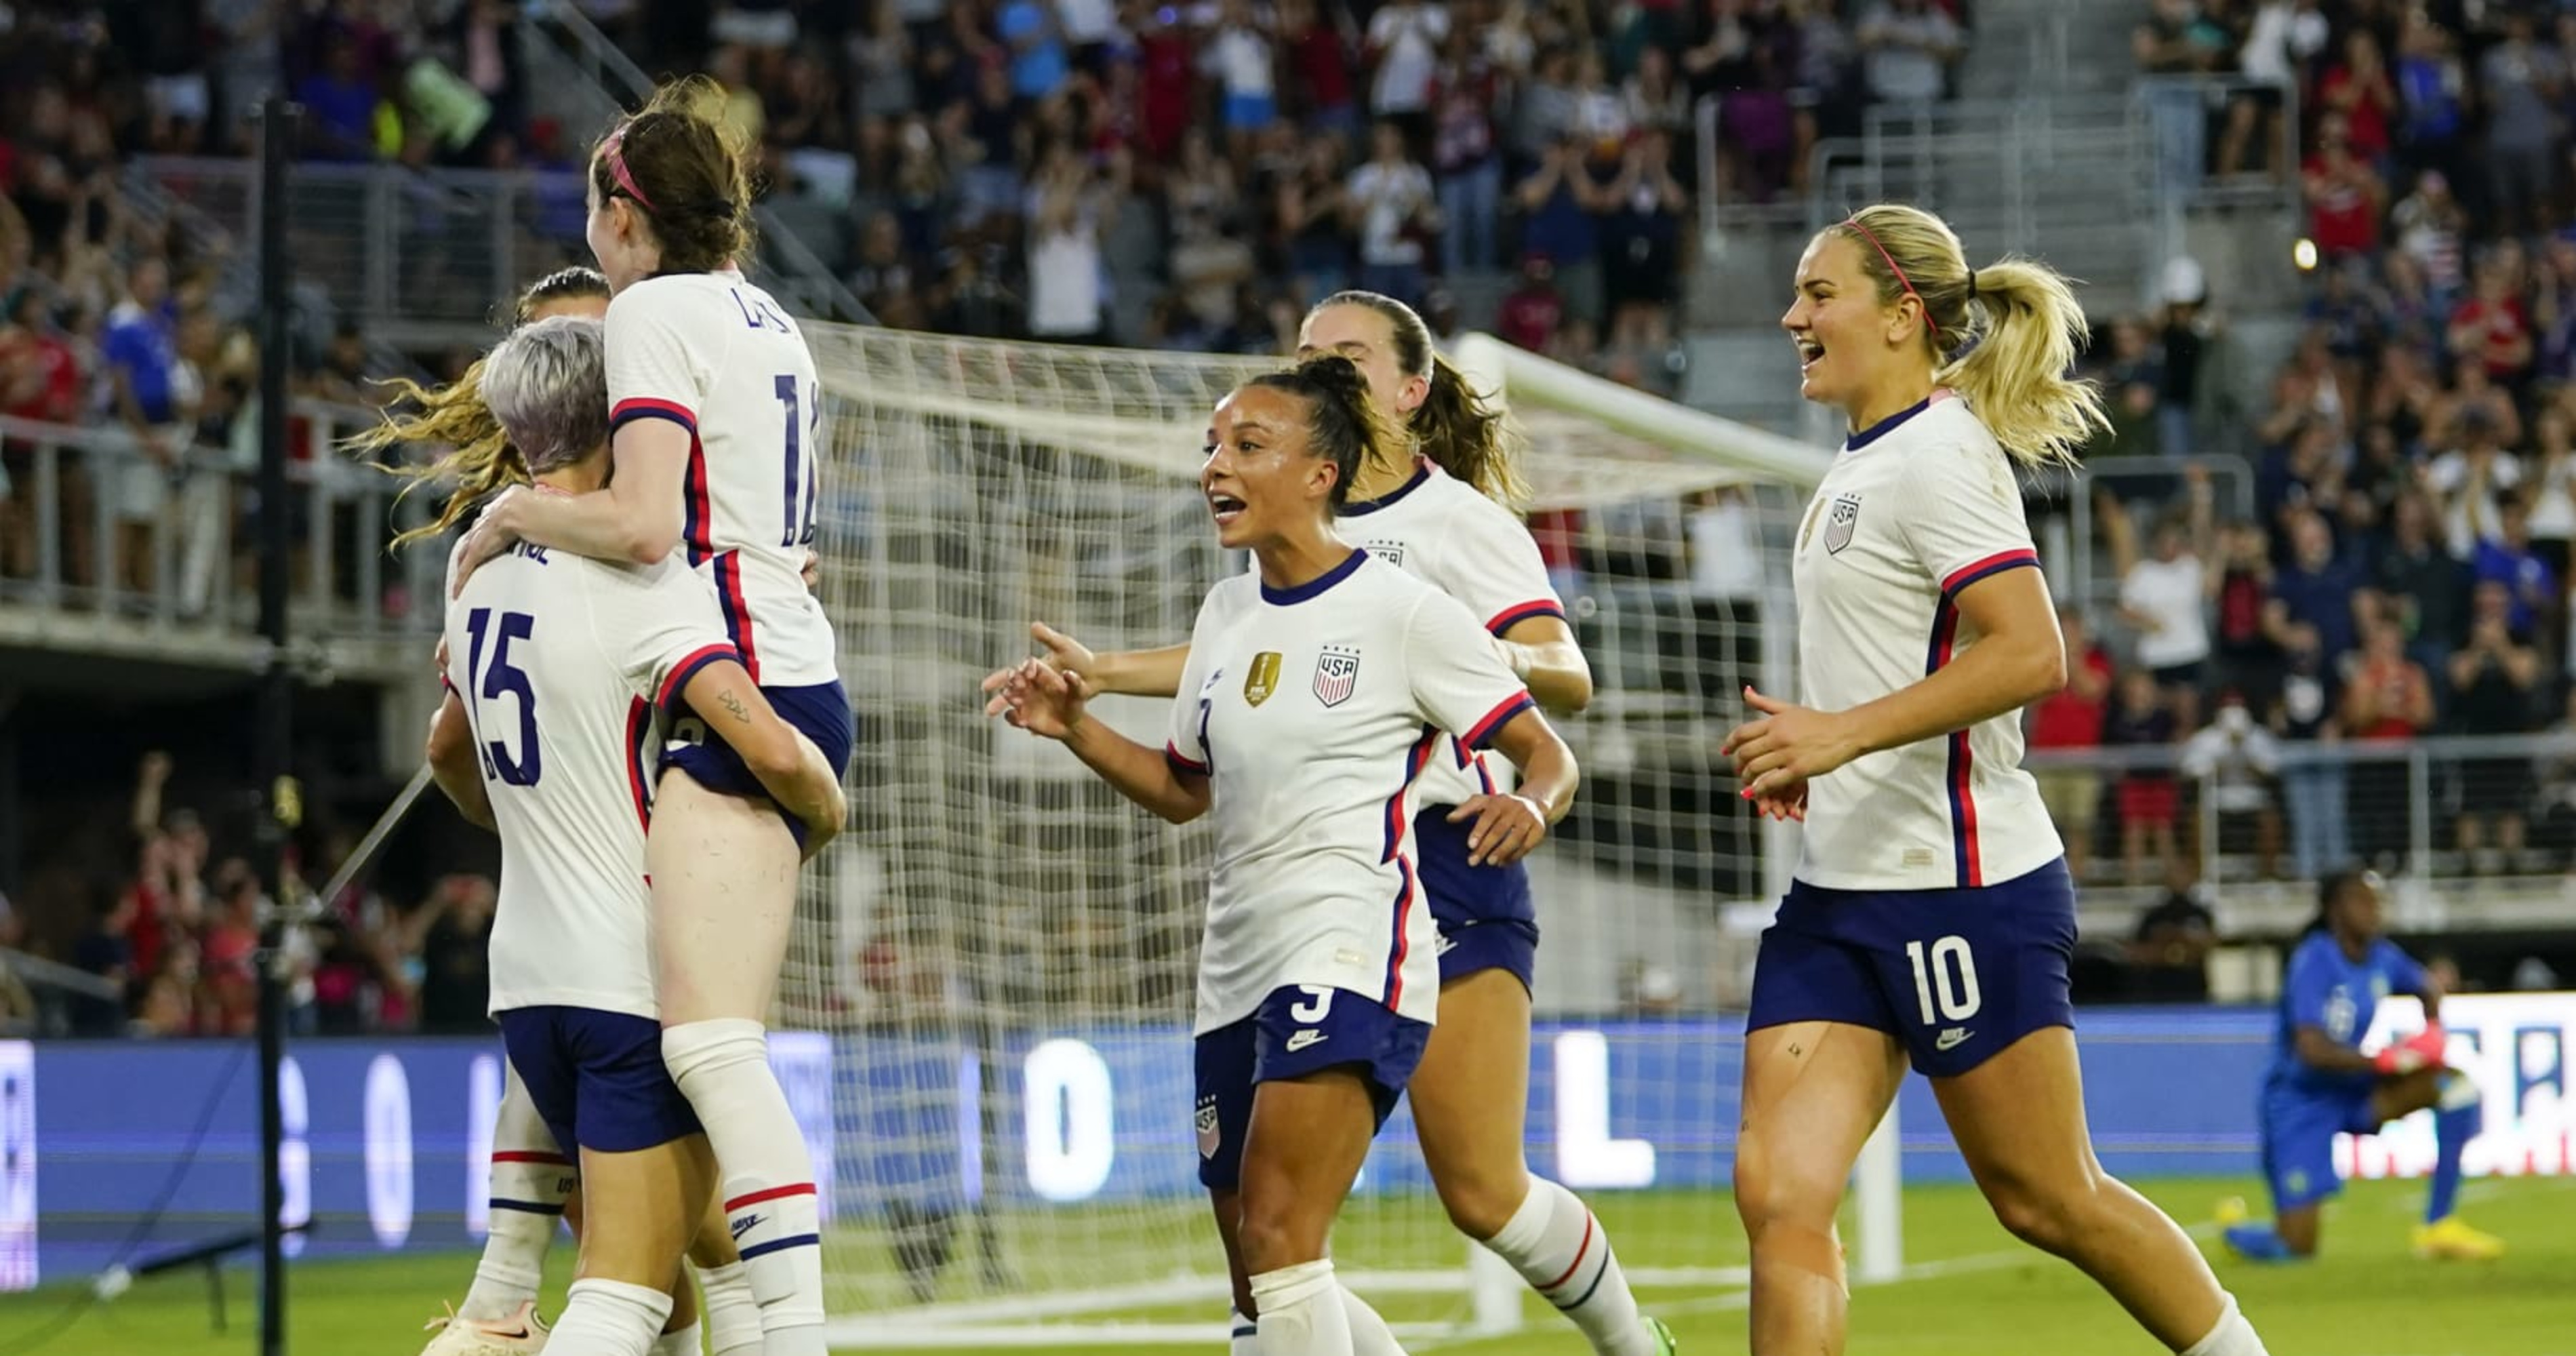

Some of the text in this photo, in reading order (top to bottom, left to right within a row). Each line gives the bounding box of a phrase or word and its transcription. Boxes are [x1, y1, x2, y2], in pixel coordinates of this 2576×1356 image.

[1832, 504, 1855, 523] USA
[466, 607, 542, 788] 15
[1321, 657, 1354, 677] USA
[1906, 935, 1982, 1026] 10
[1555, 1030, 1656, 1189] L
